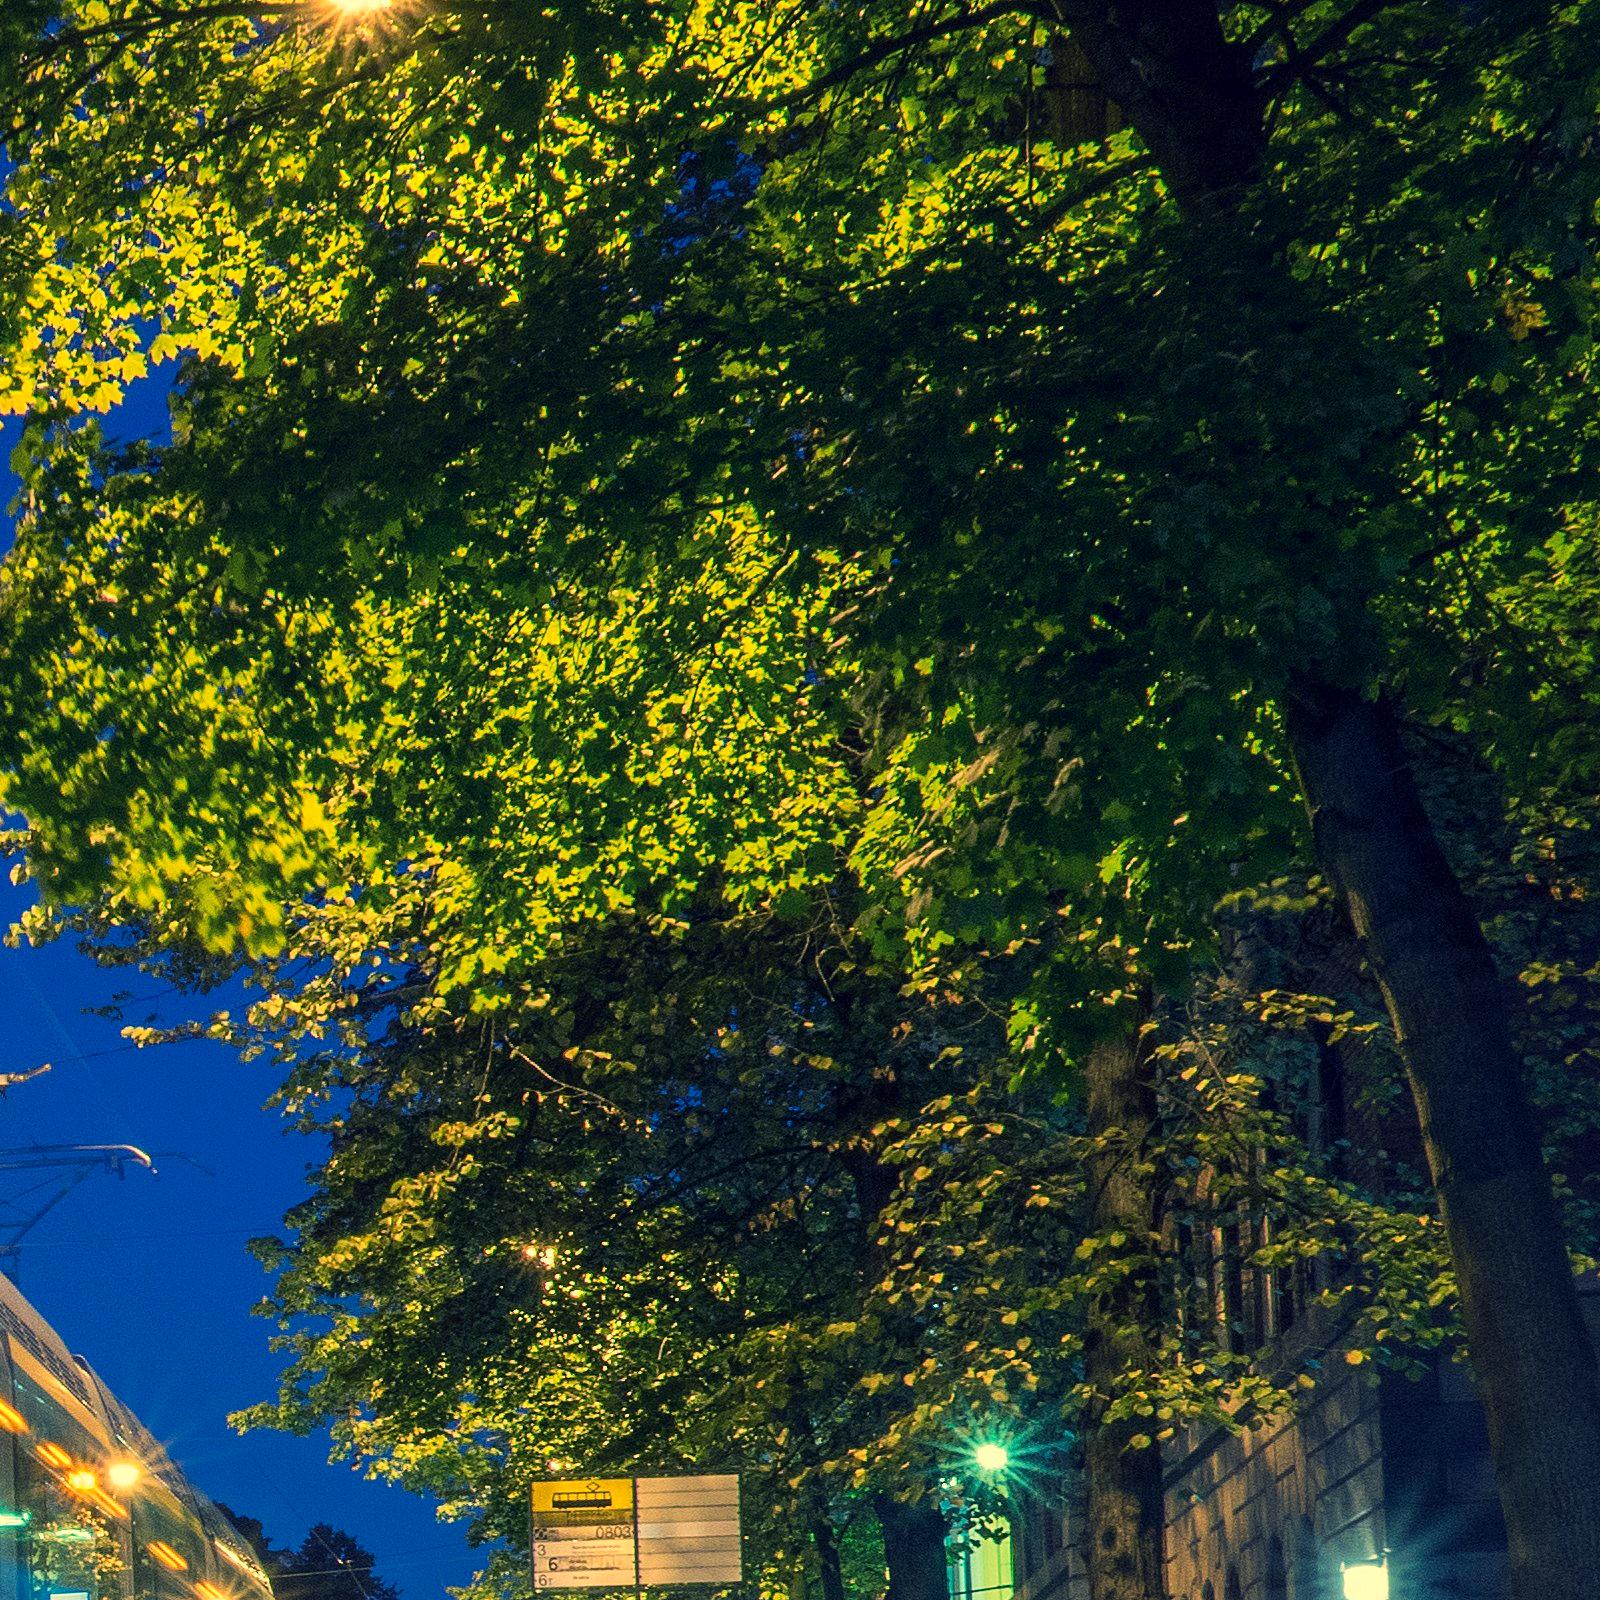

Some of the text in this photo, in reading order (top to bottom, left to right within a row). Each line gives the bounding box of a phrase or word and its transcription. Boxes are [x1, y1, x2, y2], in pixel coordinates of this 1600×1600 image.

[595, 1525, 632, 1539] 0803
[537, 1544, 546, 1556] 3
[548, 1557, 558, 1571] 6
